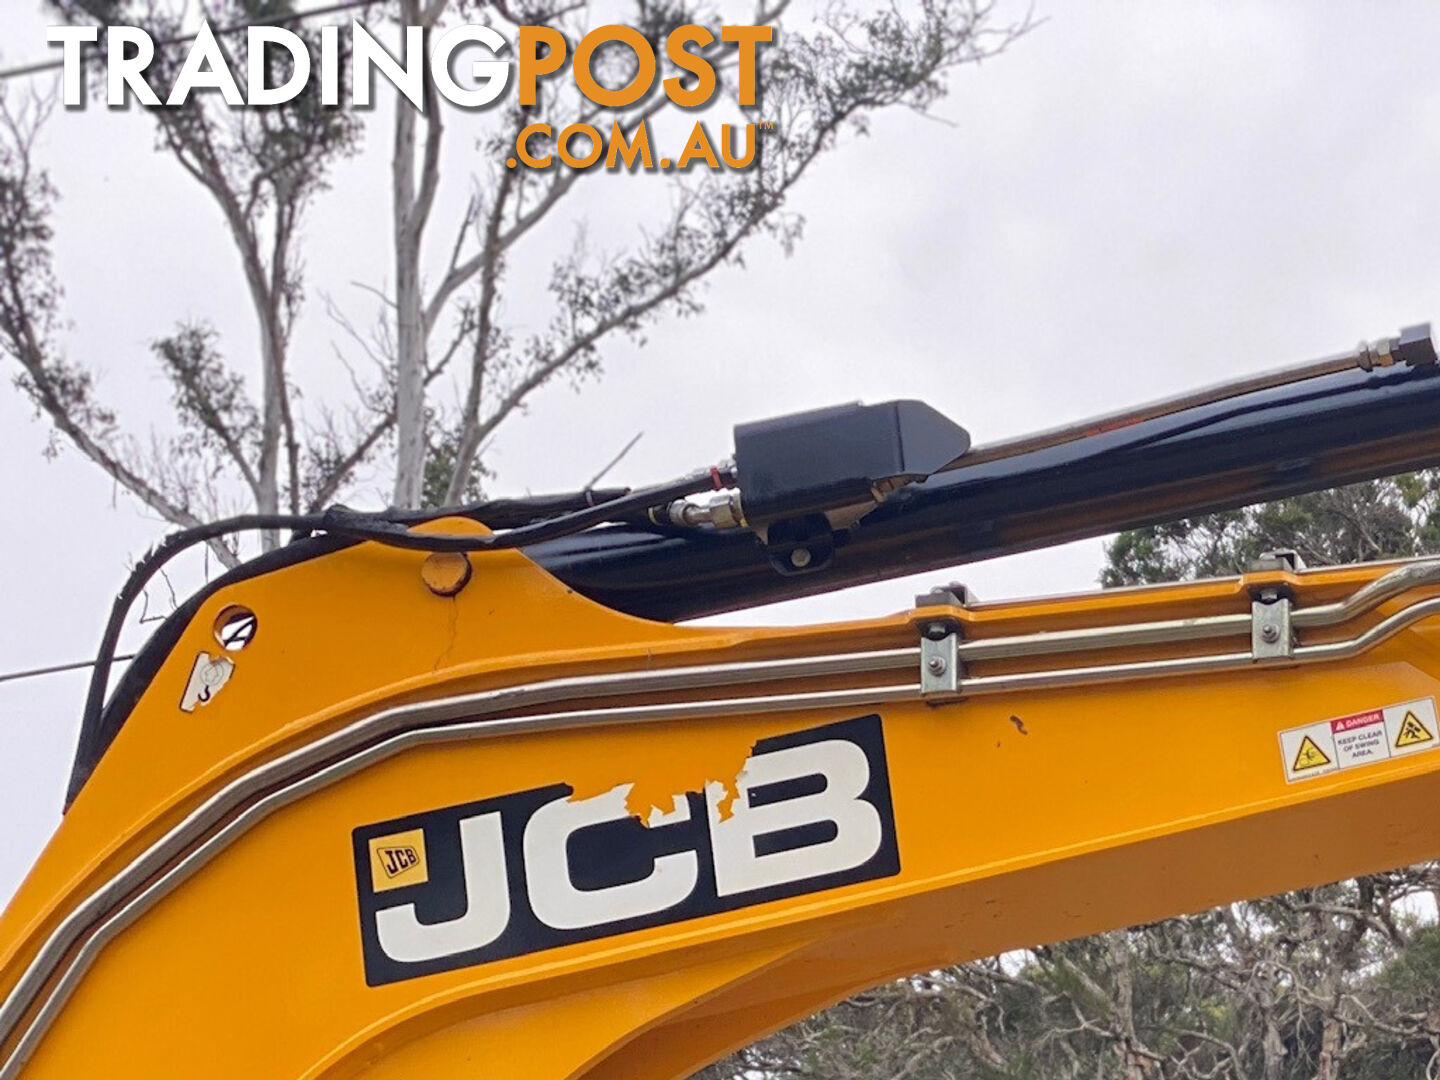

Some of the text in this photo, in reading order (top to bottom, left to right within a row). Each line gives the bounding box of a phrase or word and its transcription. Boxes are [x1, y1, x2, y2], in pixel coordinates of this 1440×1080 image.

[1346, 713, 1380, 728] DANGER
[1337, 730, 1383, 745] KEEP CLEAR
[1343, 740, 1379, 752] OF SWING
[375, 739, 882, 963] JCB
[385, 847, 420, 878] JCB
